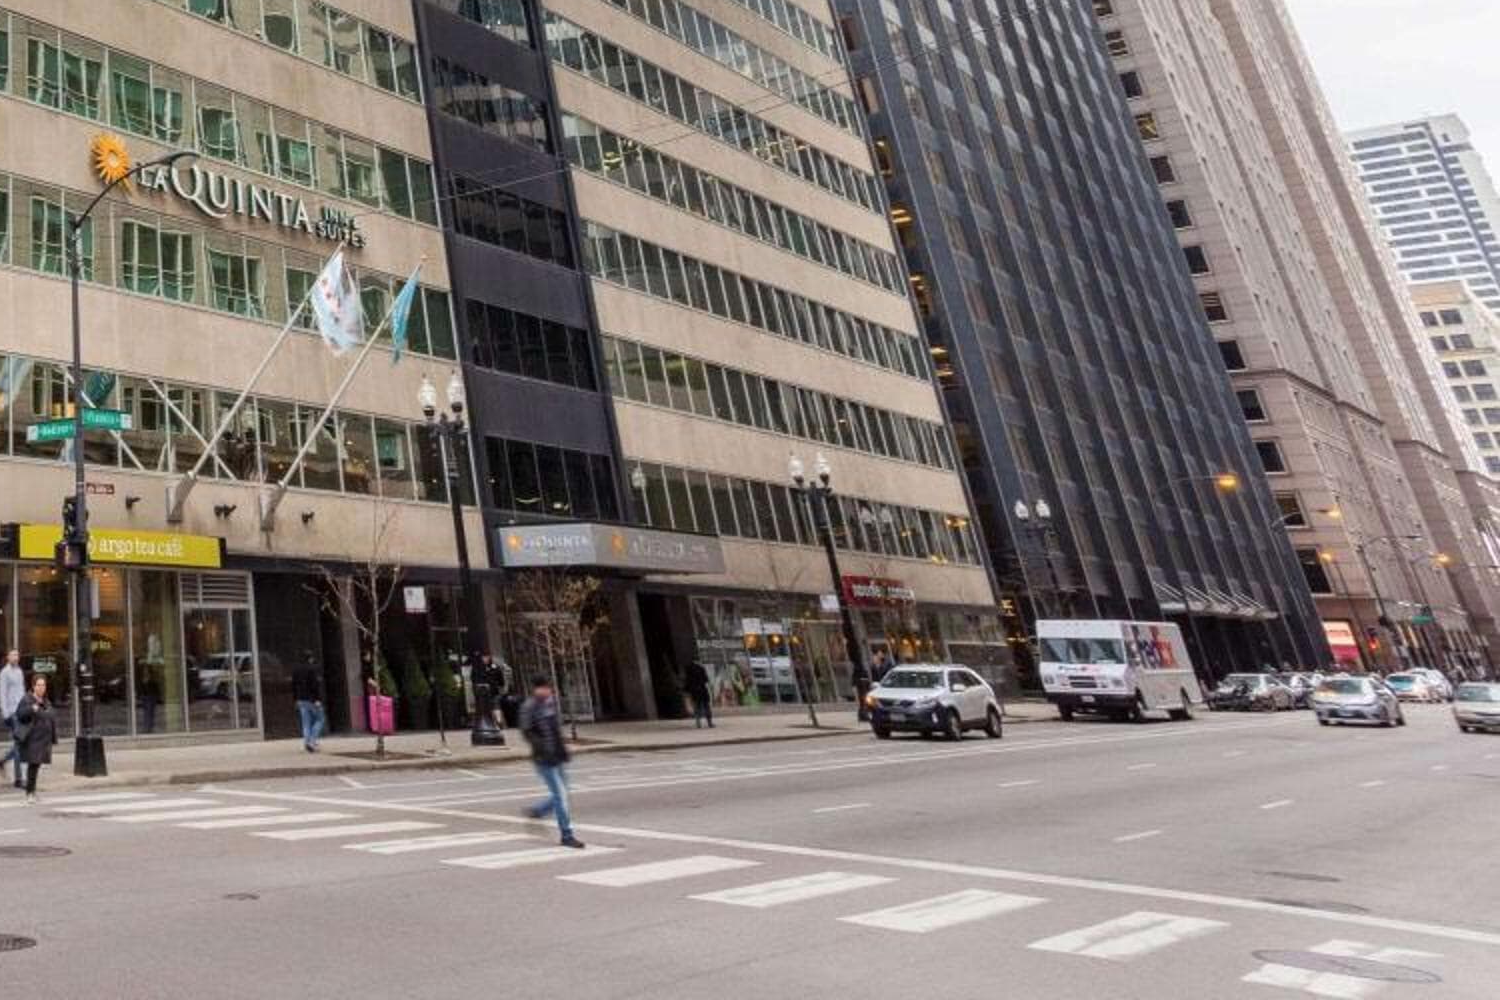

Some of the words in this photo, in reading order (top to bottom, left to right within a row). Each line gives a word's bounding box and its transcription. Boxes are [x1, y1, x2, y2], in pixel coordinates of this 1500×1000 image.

[140, 166, 169, 192] LA
[171, 157, 315, 234] QUINTA
[100, 538, 133, 559] argo
[135, 538, 155, 556] tea
[157, 537, 182, 556] café
